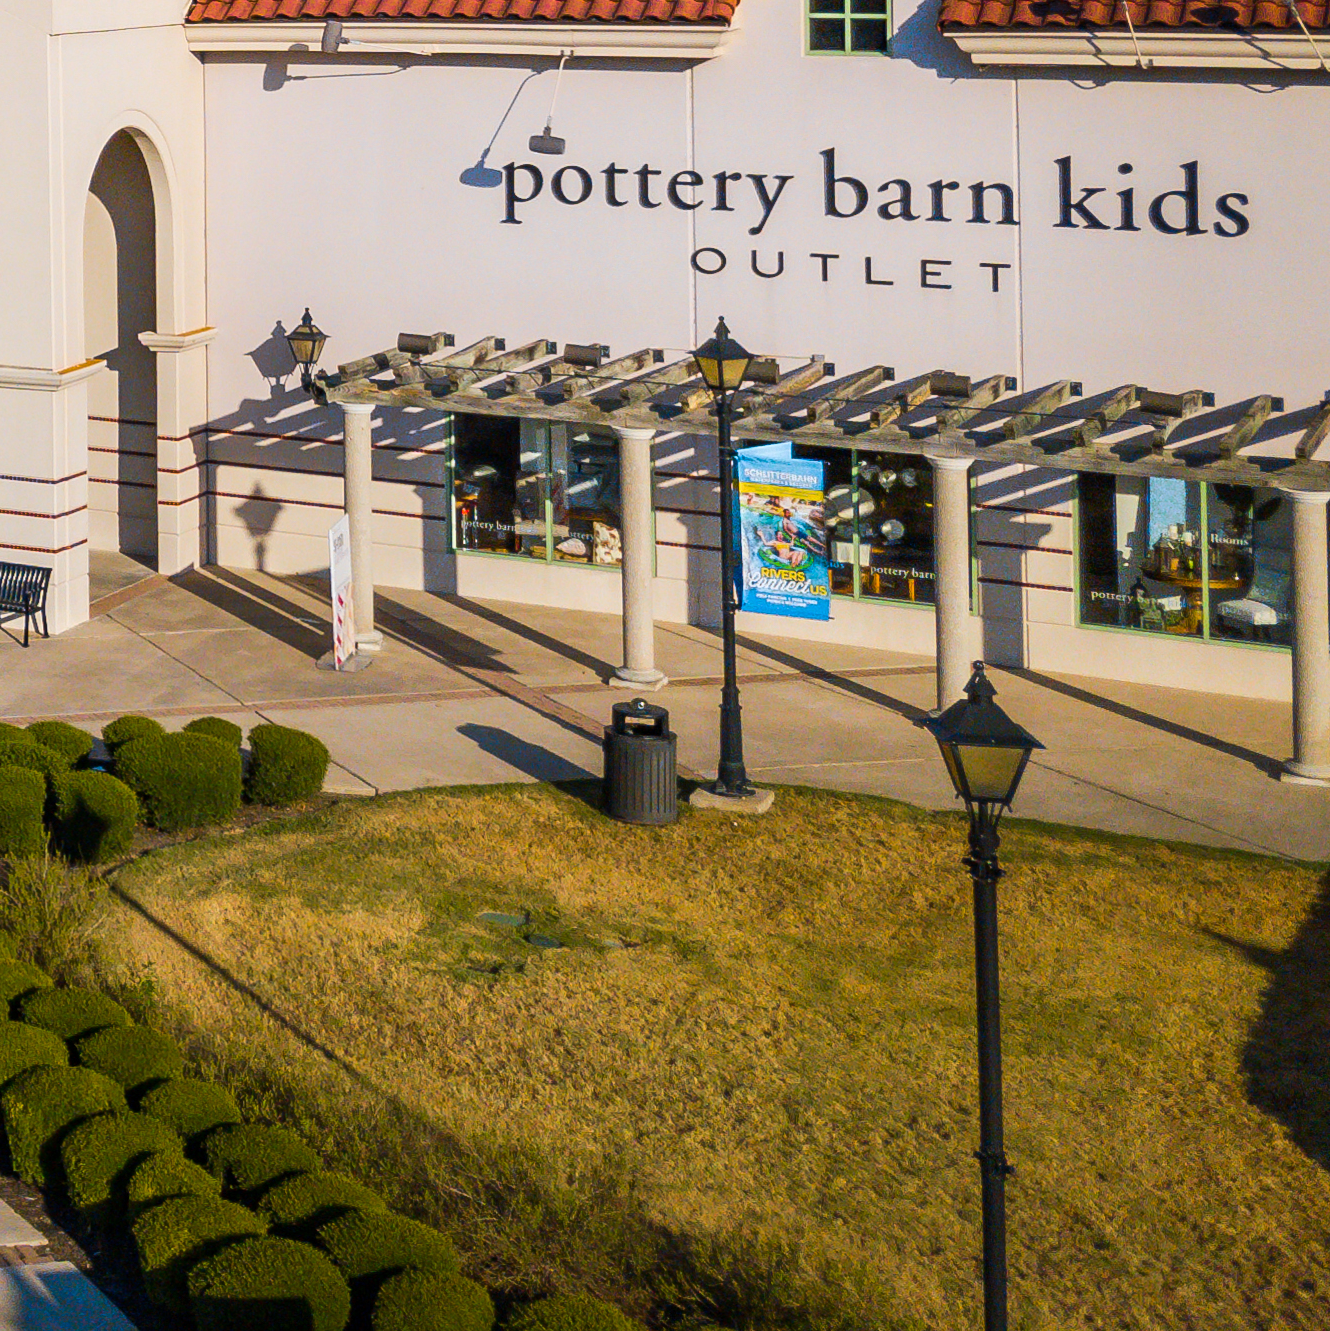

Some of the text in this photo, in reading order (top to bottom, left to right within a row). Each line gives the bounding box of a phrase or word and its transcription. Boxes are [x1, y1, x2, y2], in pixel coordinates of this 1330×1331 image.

[499, 146, 1252, 239] pottery barn kids
[689, 246, 1012, 294] OUTLET
[747, 571, 828, 596] Connect US
[760, 566, 806, 582] RIVERS
[870, 566, 910, 578] pottery
